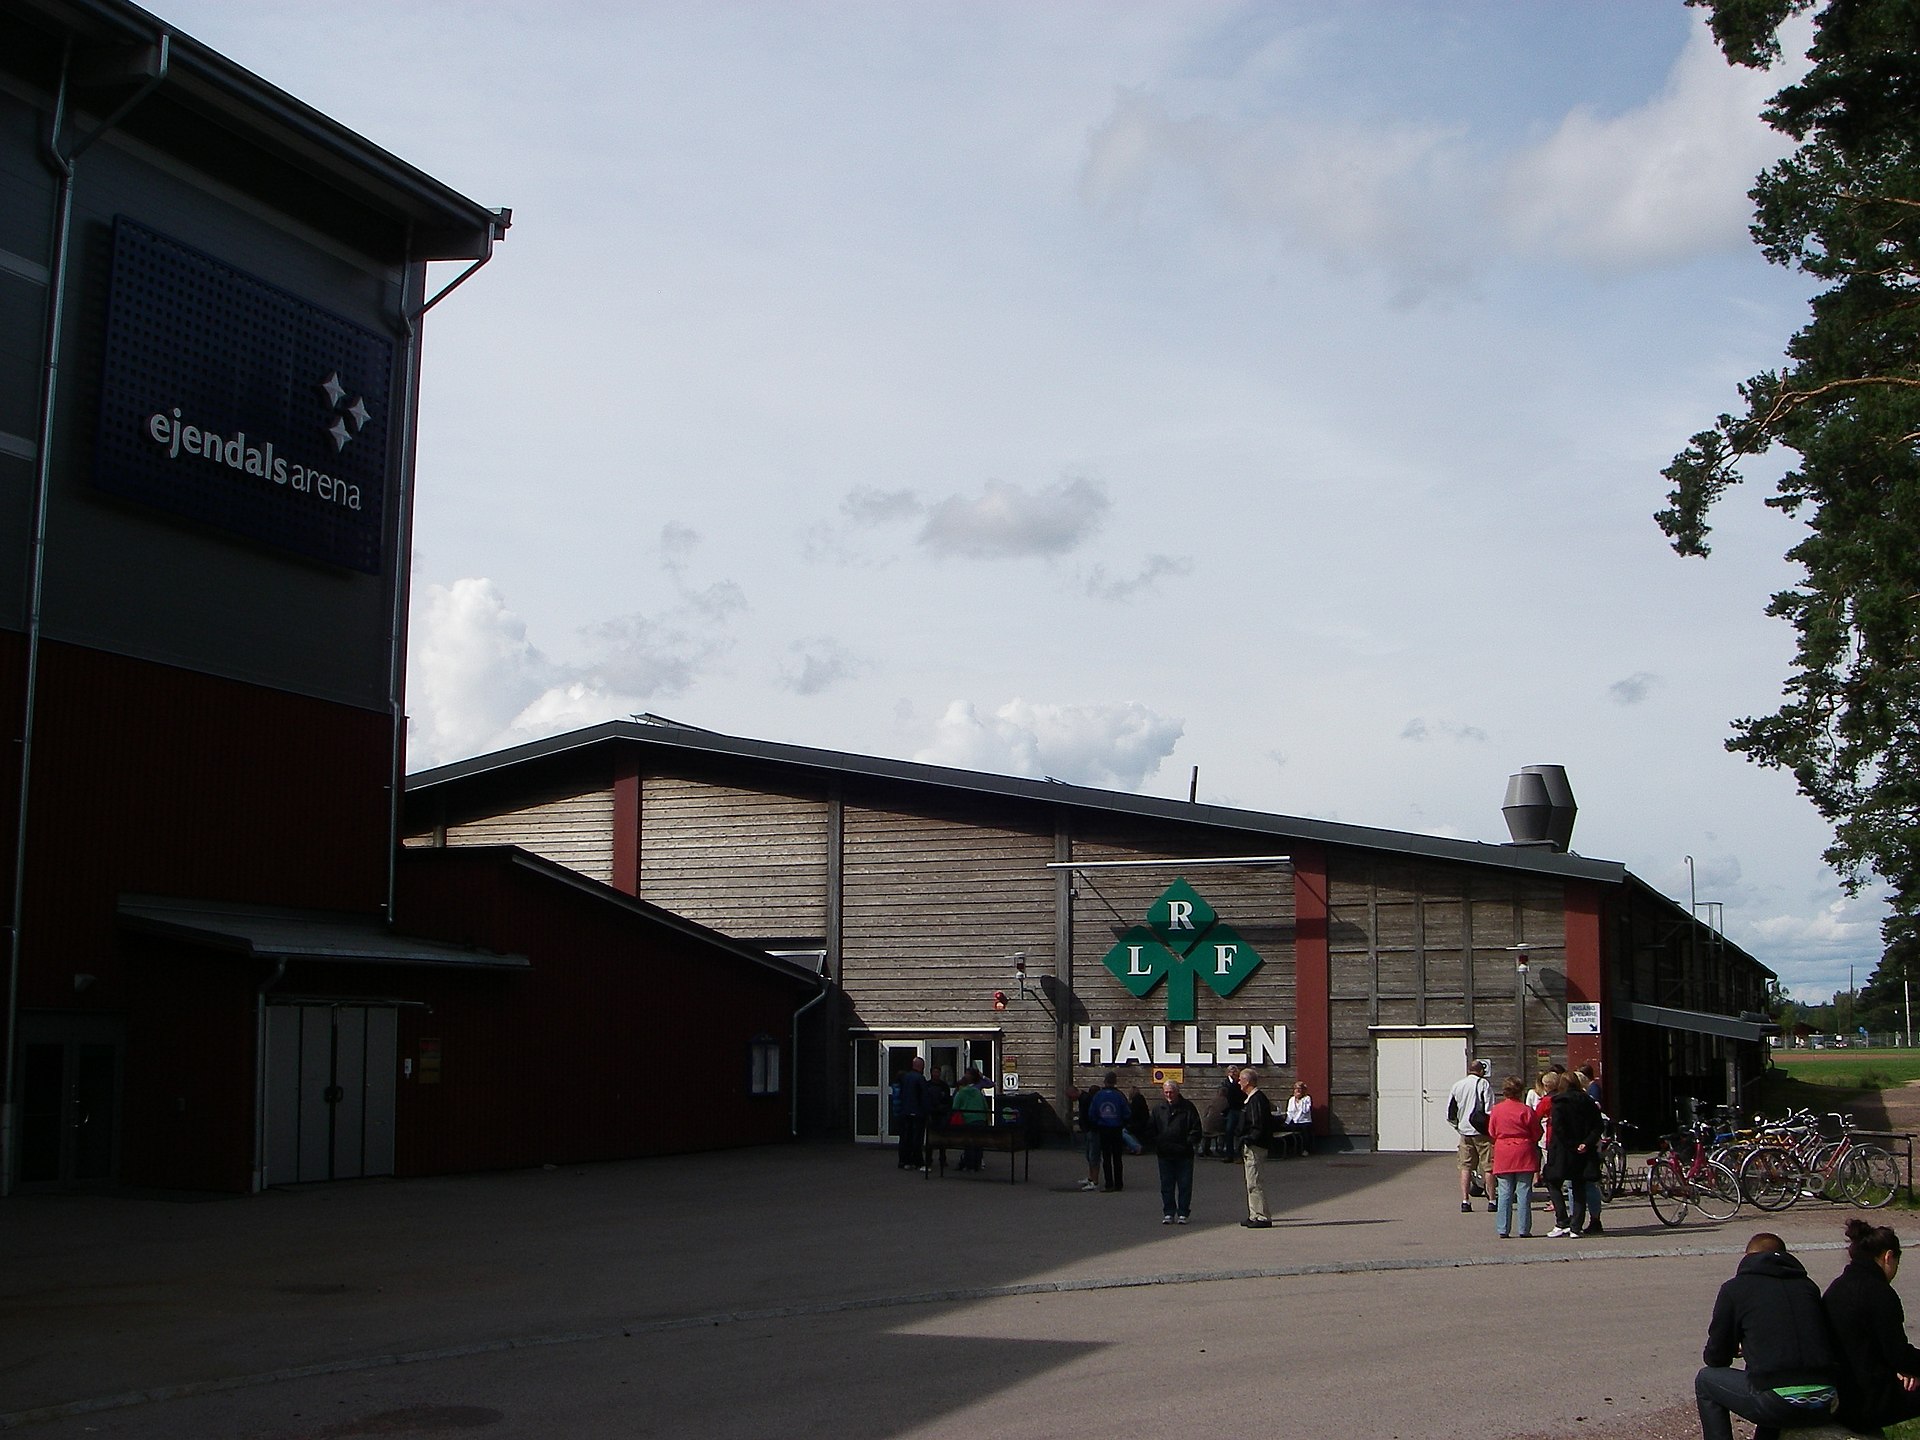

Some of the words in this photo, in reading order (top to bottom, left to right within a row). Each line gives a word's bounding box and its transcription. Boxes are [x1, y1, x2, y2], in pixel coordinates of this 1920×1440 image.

[149, 407, 288, 485] ejendals
[291, 463, 362, 511] arena
[1167, 901, 1195, 930] R
[1127, 945, 1152, 975] L
[1213, 944, 1238, 975] F
[1078, 1025, 1288, 1065] HALLEN
[1006, 1076, 1015, 1086] 11
